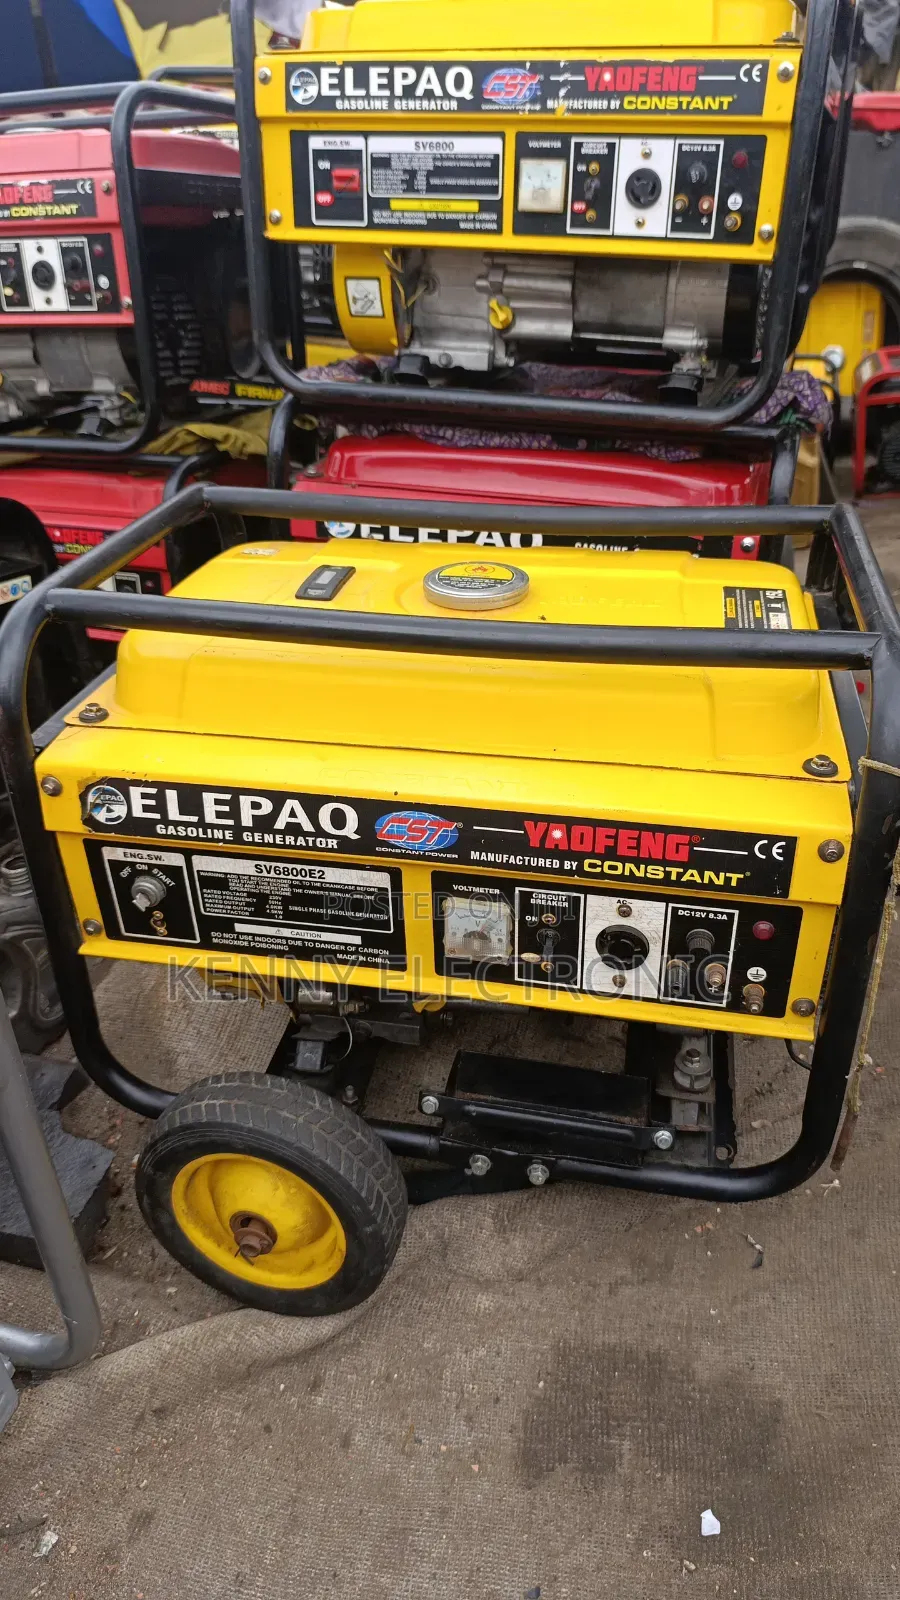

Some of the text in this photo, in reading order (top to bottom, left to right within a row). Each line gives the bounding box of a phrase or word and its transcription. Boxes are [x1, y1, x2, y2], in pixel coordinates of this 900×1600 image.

[320, 66, 474, 99] ELEPAQ
[585, 66, 698, 92] YAOFENG
[336, 99, 458, 111] GASOLINE GENERATOR
[610, 98, 620, 110] BY
[623, 95, 733, 110] CONSTANT
[414, 141, 455, 151] SV6800
[11, 203, 79, 217] CONSTANT
[129, 786, 361, 840] ELEPAQ
[156, 824, 339, 849] GASOLINE GENERATOR
[377, 817, 458, 844] CST
[524, 820, 690, 862] YAOFENG
[122, 851, 165, 862] ENG.SW.
[375, 846, 459, 859] CONSTANT POWER
[470, 850, 579, 870] MANUFACTURED BY
[119, 865, 132, 878] OFF
[152, 868, 176, 888] START
[254, 864, 326, 880] SV6800E2
[583, 859, 744, 887] CONSTANT
[250, 876, 292, 884] RECOMMENDED
[322, 883, 356, 891] CRANKCASE
[452, 884, 500, 895] VOLTMETER
[223, 895, 257, 903] FREQUENCY
[530, 898, 569, 908] BREAKER
[532, 892, 567, 901] CIRCUIT
[309, 906, 327, 914] PHASE
[327, 908, 355, 917] GASOLINE
[678, 909, 728, 921] DC12V 8.3A
[291, 930, 322, 939] CAUTION
[212, 937, 289, 951] MONOXIDE POISONING
[255, 936, 287, 945] INDOORS
[315, 942, 346, 951] DANGER
[358, 947, 390, 955] CARBON
[367, 956, 391, 964] CHINA
